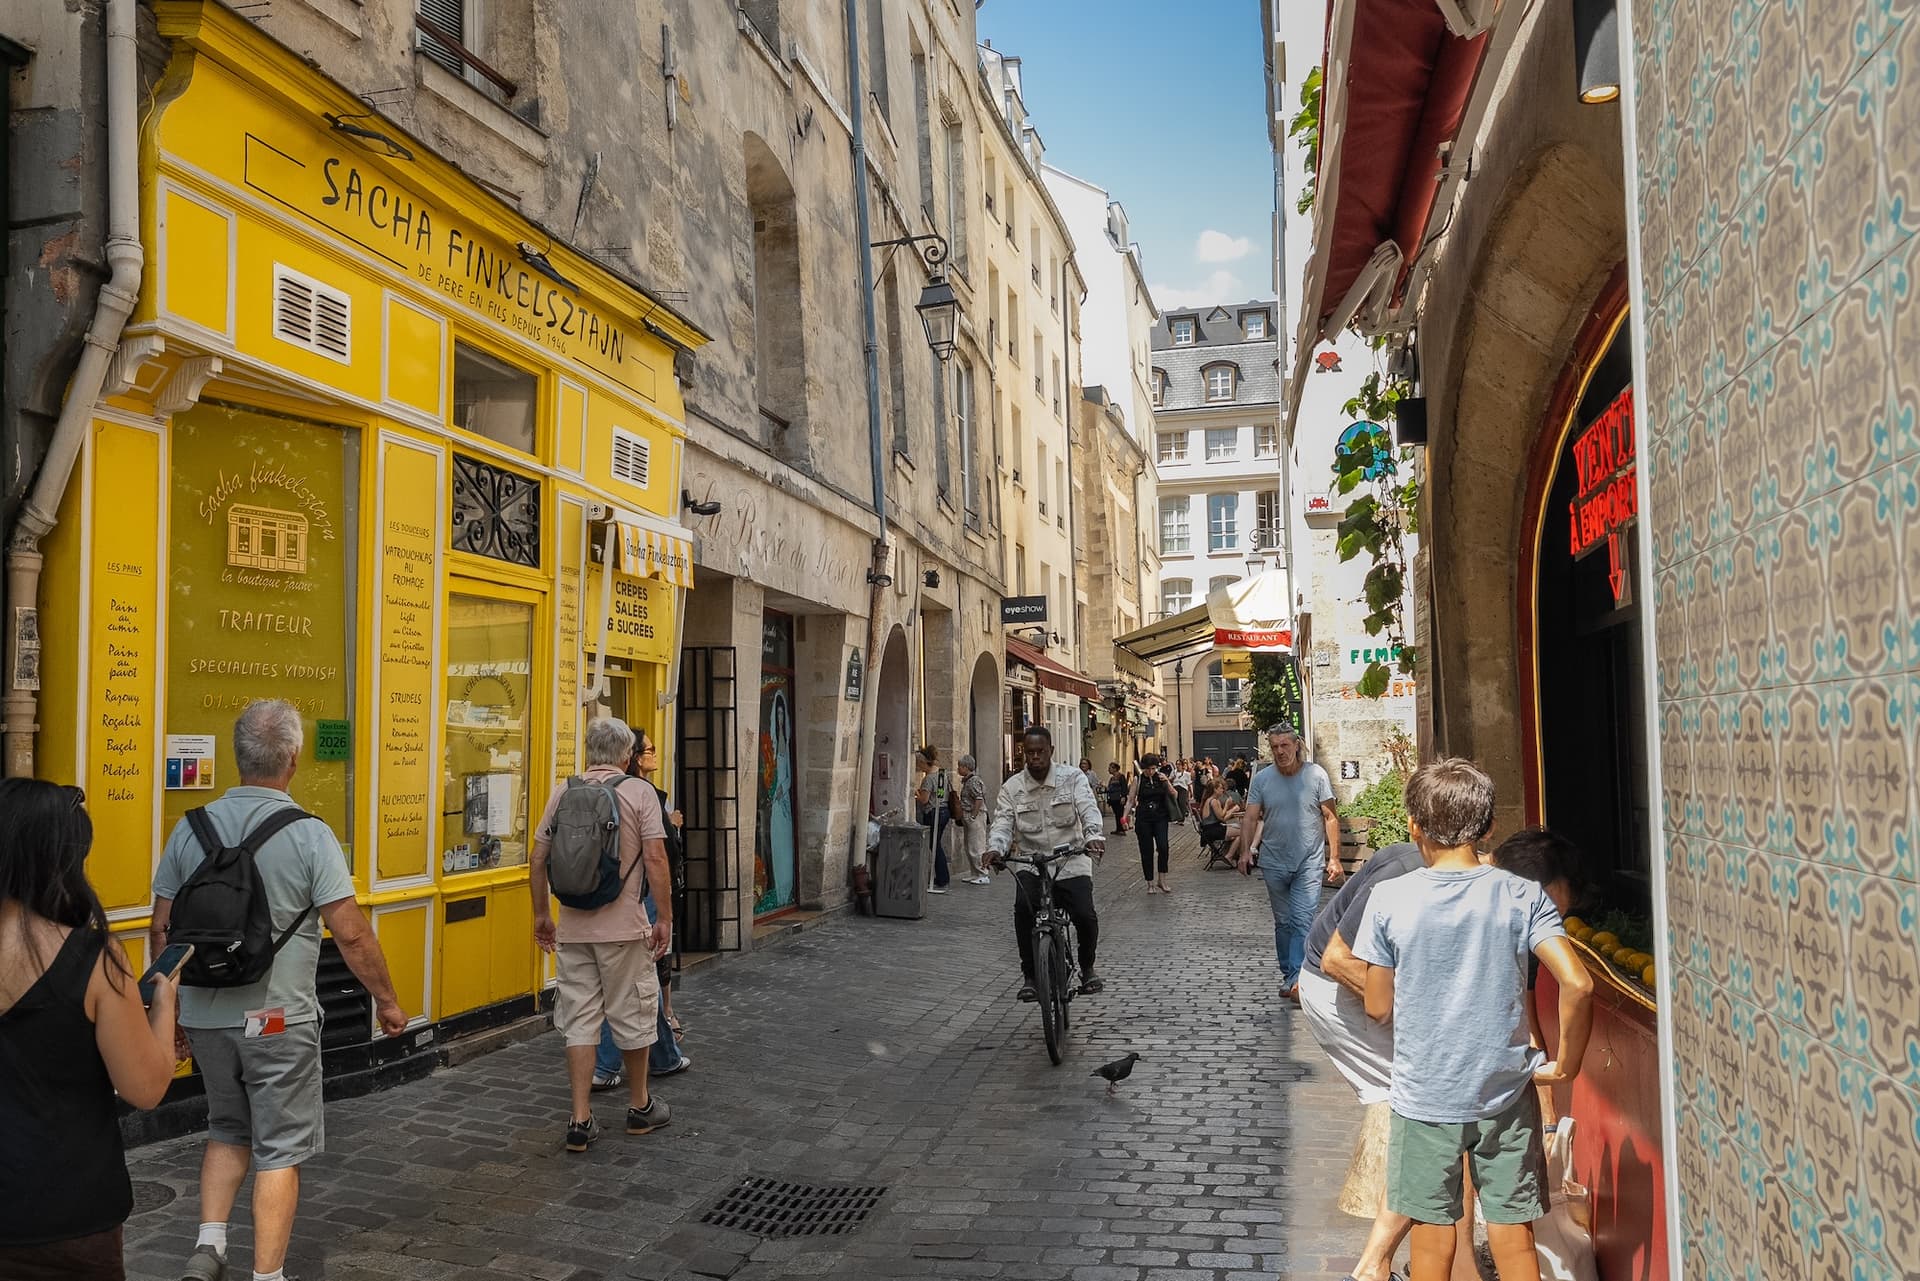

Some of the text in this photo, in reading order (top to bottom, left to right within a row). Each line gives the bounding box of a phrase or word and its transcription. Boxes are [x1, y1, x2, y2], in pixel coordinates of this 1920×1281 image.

[321, 158, 624, 364] SACHA FINKELSZTAJN
[417, 263, 567, 354] DE PERE EN FILS DEPUIS 1946
[200, 469, 243, 525] Sacha
[389, 521, 400, 531] LES
[385, 545, 433, 565] VATROUCHKAS
[626, 537, 646, 560] Sacha
[107, 562, 142, 575] LES PAINS
[404, 562, 414, 573] AU
[237, 569, 281, 590] boutique
[283, 576, 313, 592] jaune
[392, 573, 424, 591] FROMAGE
[615, 580, 648, 601] CRÊPES
[110, 598, 138, 613] Pains
[615, 600, 648, 620] SALÉES
[1005, 604, 1044, 615] eyeshow
[219, 609, 313, 637] TRAITEUR
[400, 611, 416, 625] Light
[107, 621, 140, 633] cumin
[607, 617, 654, 639] & SUCRÉES
[1228, 633, 1279, 641] RESTAURANT
[108, 643, 139, 658] Pains
[109, 667, 138, 681] pavot
[190, 658, 337, 680] SPECIALITES YIDDISH
[390, 692, 422, 705] STRUDELS
[102, 713, 142, 732] Rogalik
[107, 738, 137, 756] Bagels
[319, 736, 347, 748] 2026
[102, 763, 140, 780] Pletzels
[382, 793, 425, 806] AU CHOCOLAT
